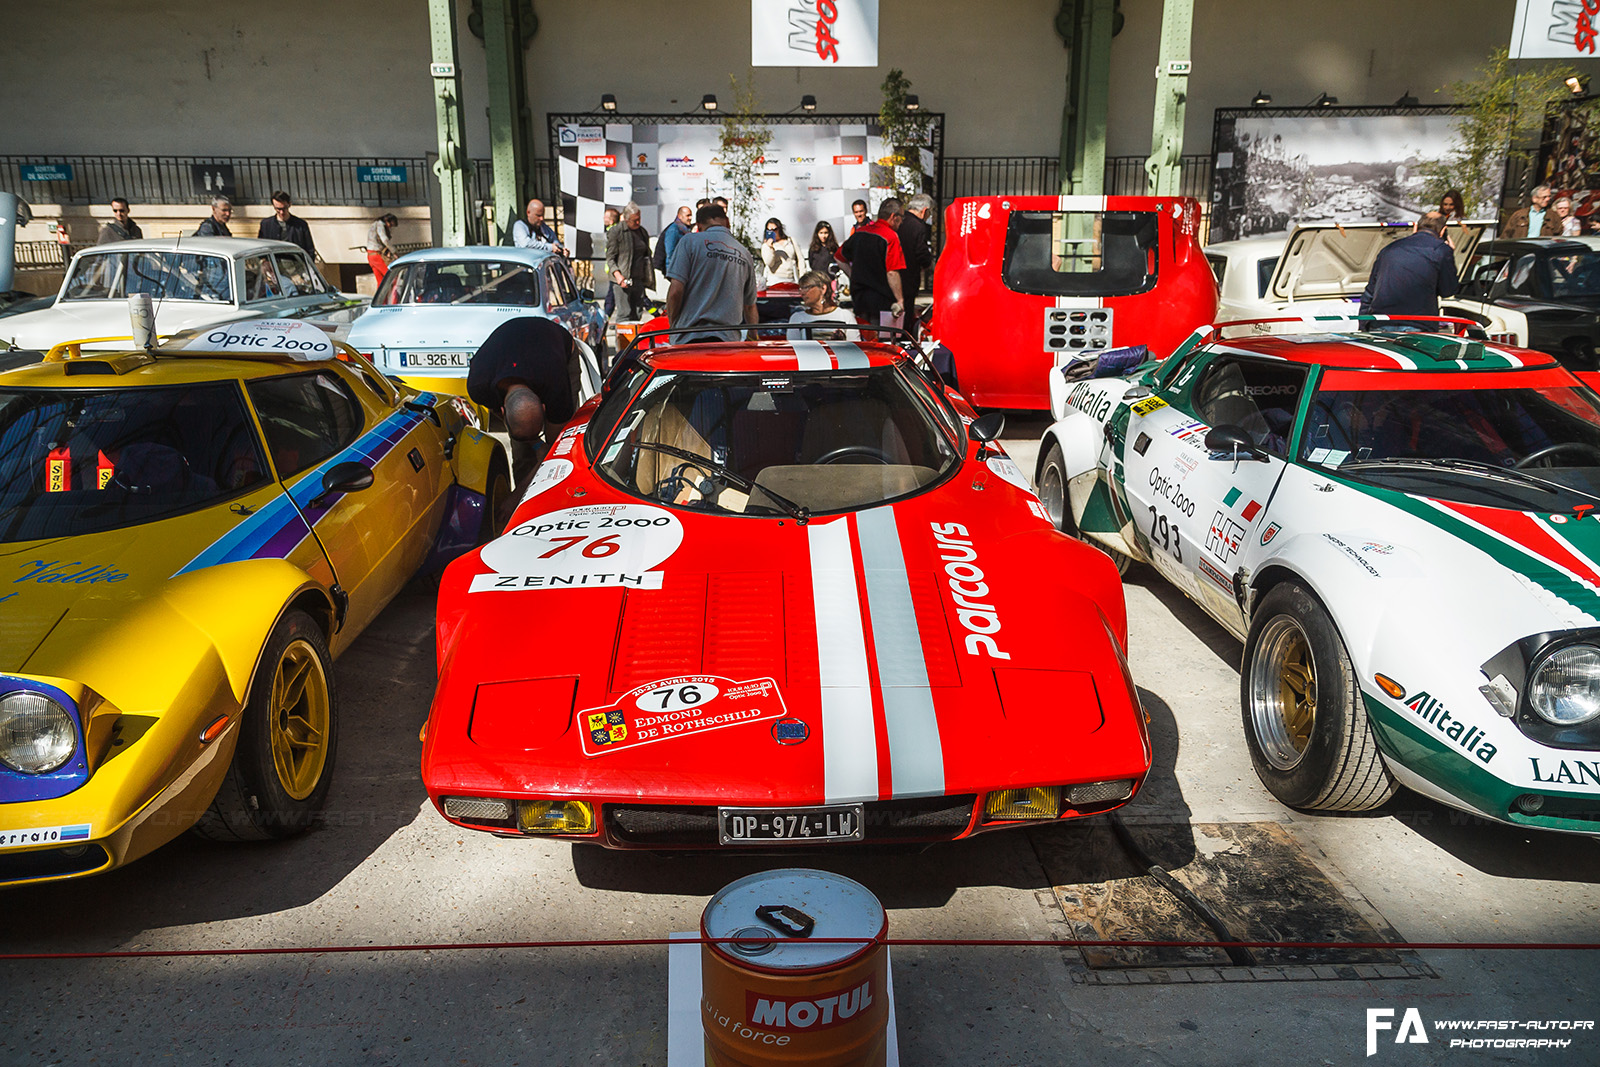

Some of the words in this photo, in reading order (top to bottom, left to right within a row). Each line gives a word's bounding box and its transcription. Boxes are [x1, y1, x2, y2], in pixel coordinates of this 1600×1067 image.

[207, 331, 268, 348] Optic
[271, 335, 328, 352] 2000
[1066, 382, 1112, 422] Alitalia
[1243, 385, 1297, 396] RECARO
[1149, 467, 1174, 500] Optic
[1172, 483, 1196, 519] 2000
[511, 518, 591, 537] Optic
[597, 517, 671, 529] 2000
[1148, 505, 1184, 564] 293
[537, 534, 622, 559] 76
[494, 573, 644, 588] ZENITH
[632, 684, 658, 697] 20-25
[659, 677, 690, 689] AVRIL
[690, 676, 716, 684] 2015
[653, 685, 702, 710] 76
[1403, 690, 1499, 764] Alitalia
[732, 811, 854, 839] DP-974-LW
[752, 980, 873, 1028] MOTUL
[732, 1021, 791, 1046] force
